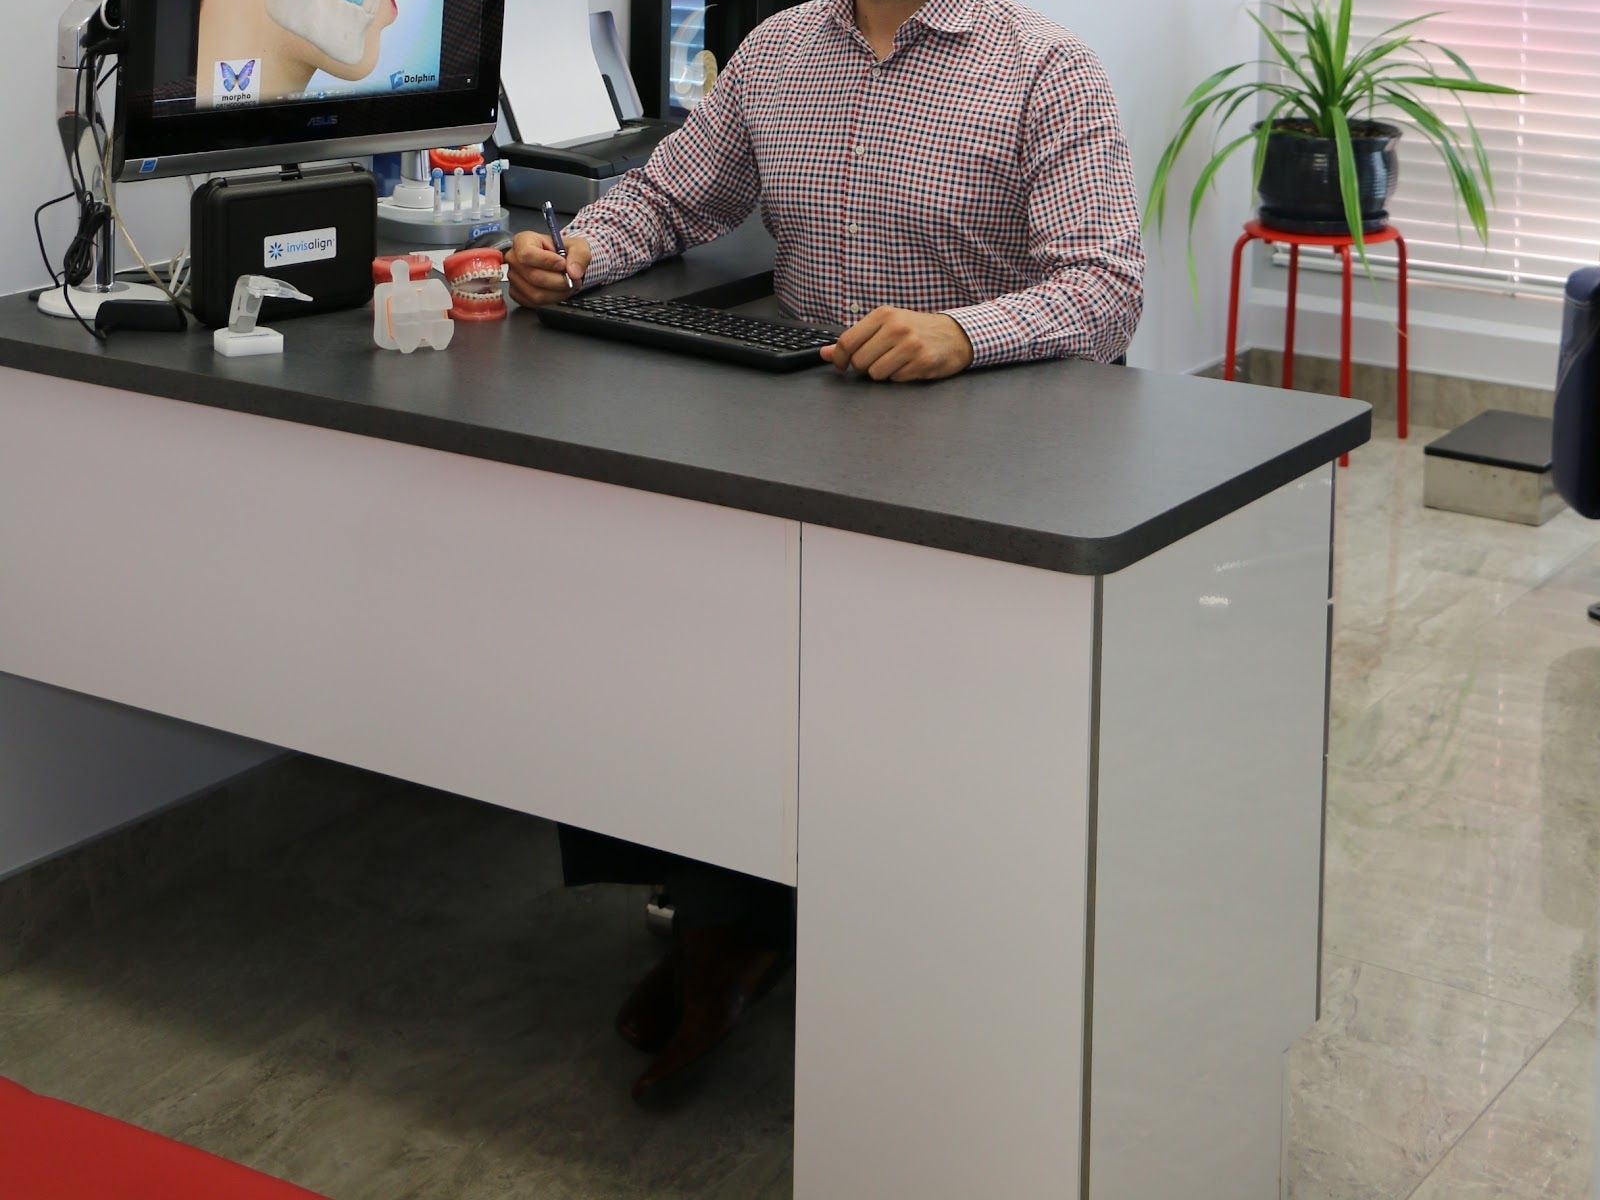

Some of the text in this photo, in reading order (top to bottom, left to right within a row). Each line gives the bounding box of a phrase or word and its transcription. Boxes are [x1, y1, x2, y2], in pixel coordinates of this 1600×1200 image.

[404, 74, 436, 84] Dolphin
[306, 115, 338, 127] ASUS
[286, 238, 333, 253] invisalign
